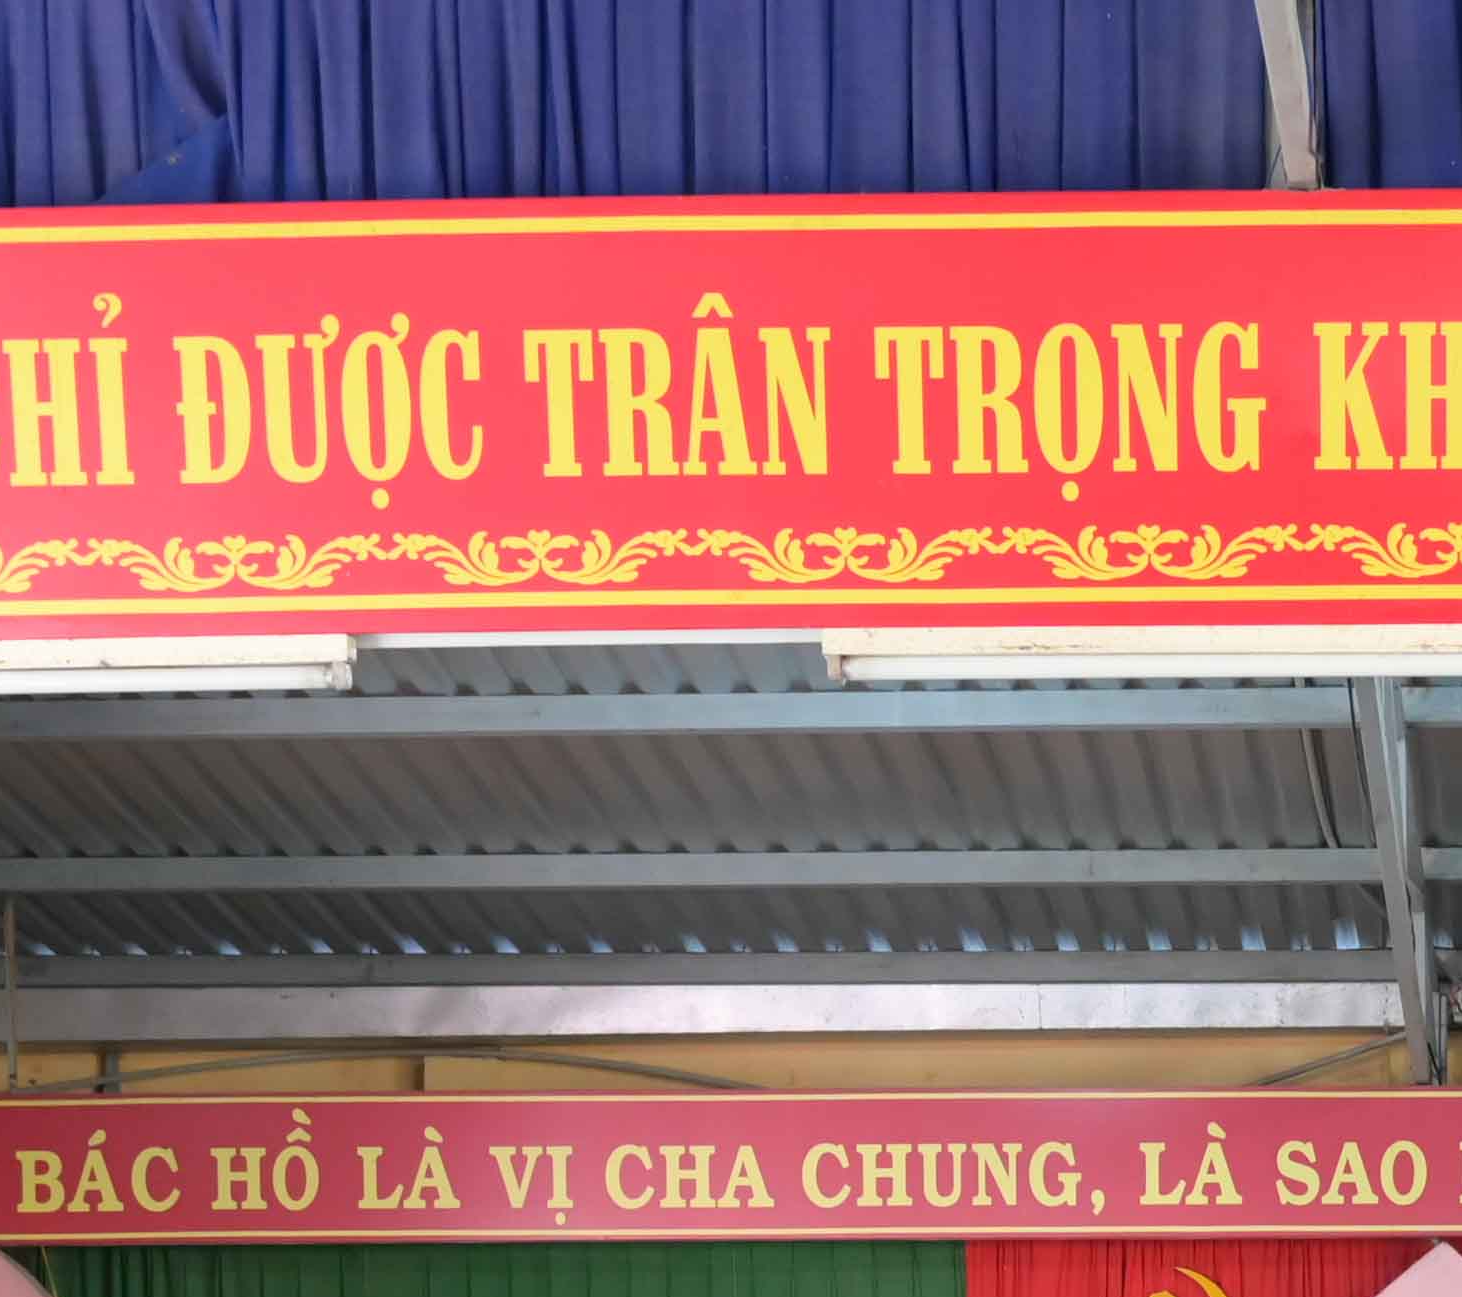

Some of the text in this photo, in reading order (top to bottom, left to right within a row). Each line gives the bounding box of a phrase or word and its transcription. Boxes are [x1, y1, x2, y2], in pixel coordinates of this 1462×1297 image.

[173, 313, 482, 509] ĐƯỢC
[524, 293, 830, 477] TRÂN
[874, 322, 1266, 501] TRỌNG
[16, 1130, 180, 1212] BÁC
[211, 1108, 319, 1210] HỒ
[357, 1127, 461, 1209] LÀ
[490, 1146, 573, 1225] VỊ
[606, 1145, 774, 1209] CHA
[802, 1142, 1105, 1215] CHUNG,
[1140, 1123, 1242, 1205] LÀ
[1276, 1141, 1427, 1205] SAO
